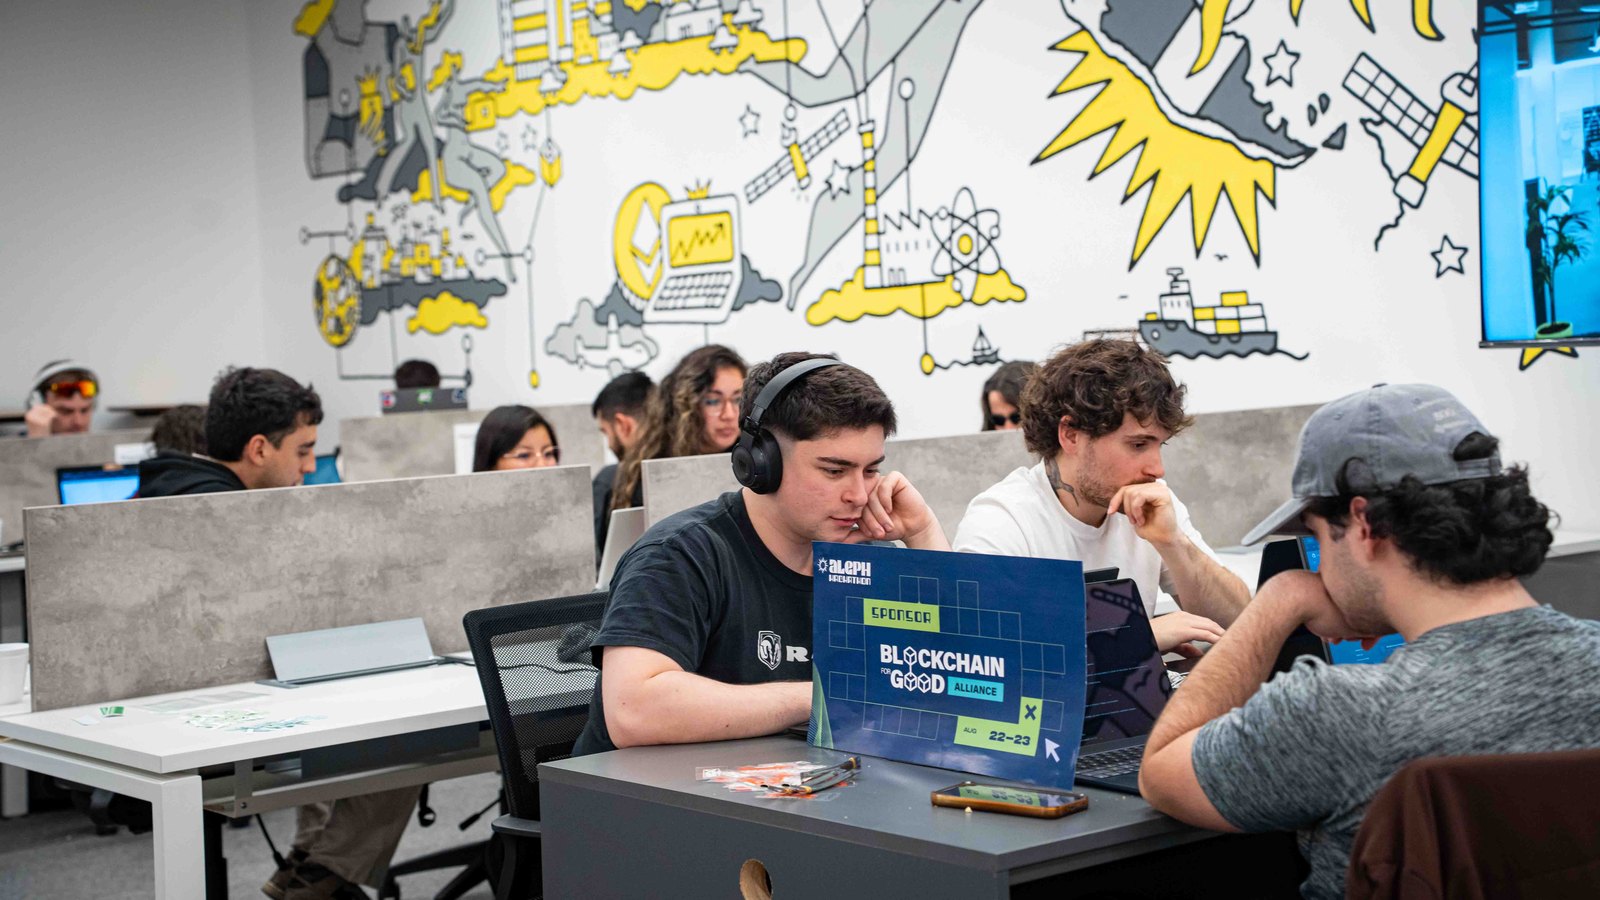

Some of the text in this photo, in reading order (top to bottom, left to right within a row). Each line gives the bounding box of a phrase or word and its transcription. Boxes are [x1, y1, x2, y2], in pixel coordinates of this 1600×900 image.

[828, 574, 871, 586] HACKATHON
[871, 606, 931, 624] SPONSOR
[880, 643, 1005, 678] BLOCKCHAIN
[880, 667, 998, 696] FOR GOOD ALLIANCE
[963, 726, 1031, 746] AUG 22-23
